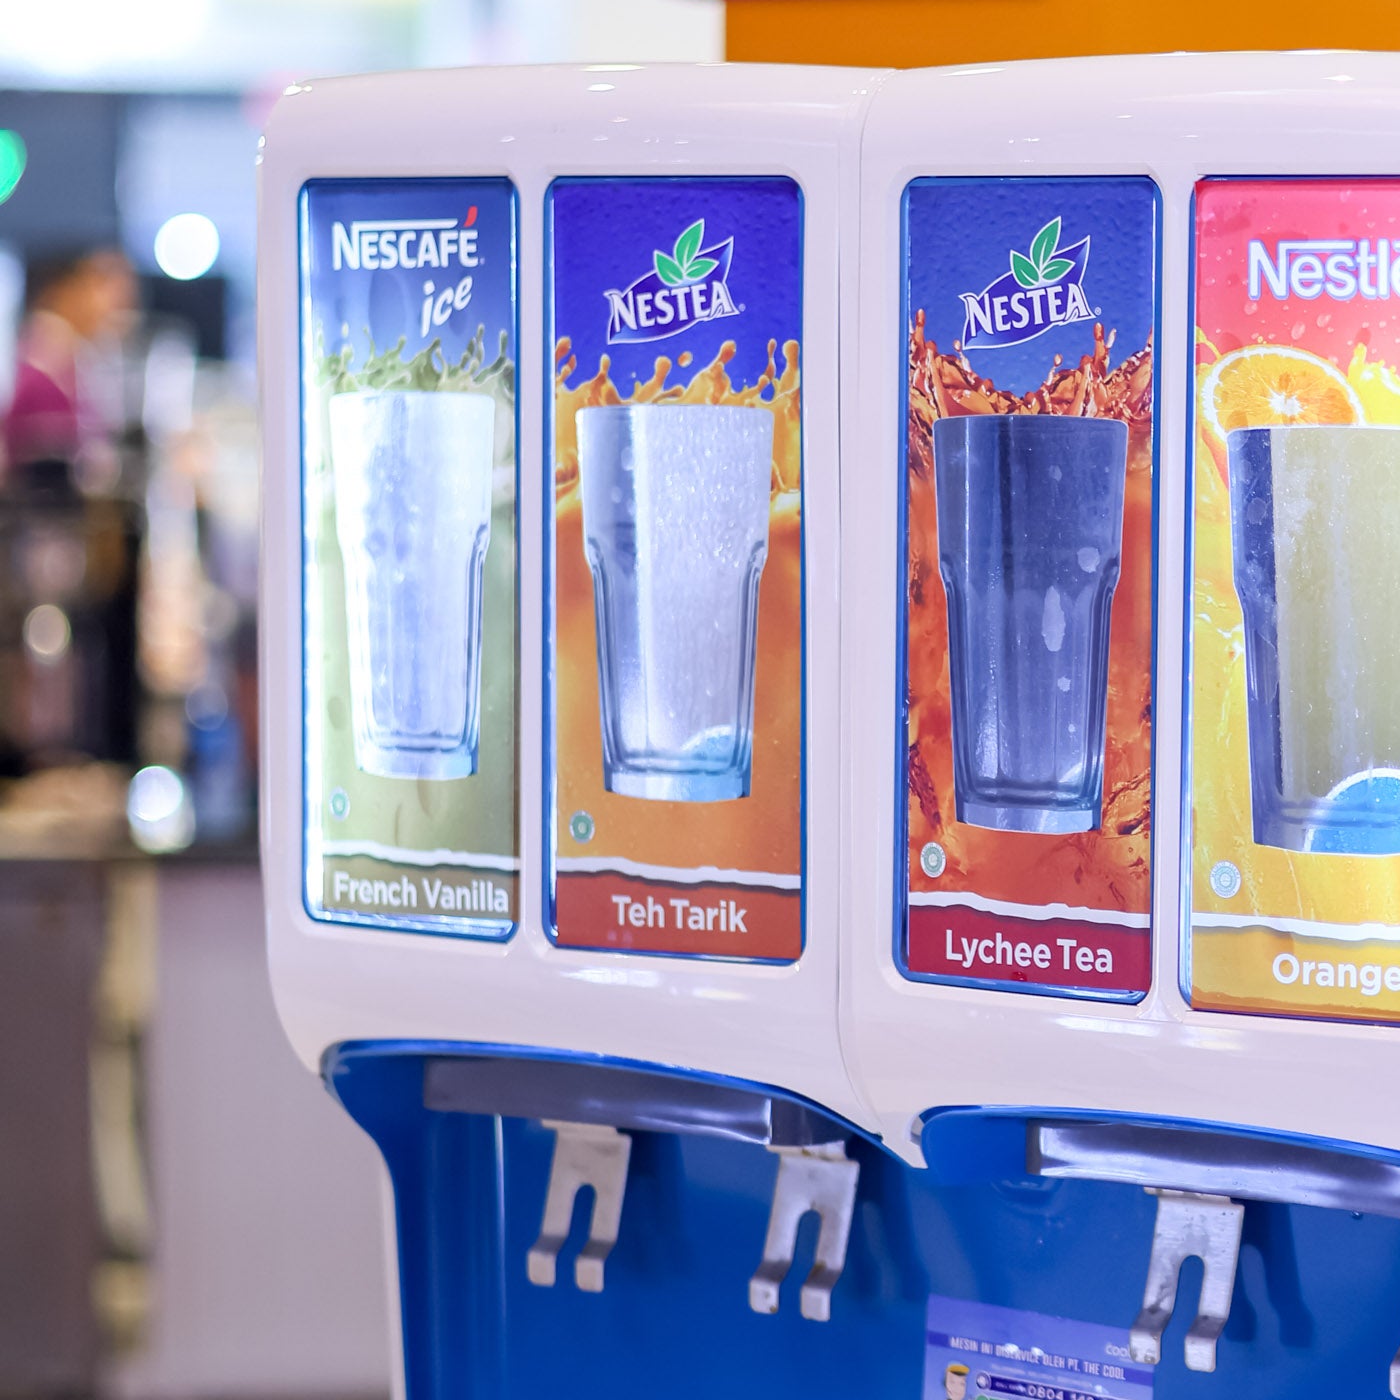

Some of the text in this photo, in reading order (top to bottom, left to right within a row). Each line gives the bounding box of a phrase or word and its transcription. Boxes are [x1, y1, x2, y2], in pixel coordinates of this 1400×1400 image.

[333, 207, 479, 270] NESCAFÉ
[421, 276, 473, 338] ice
[609, 280, 735, 334] NESTEA
[964, 283, 1092, 338] NESTEA
[333, 870, 510, 914] French Vanilla
[611, 895, 748, 934] Teh Tarik
[945, 929, 1114, 974] Lychee Tea
[950, 1335, 979, 1352] MESIN
[1042, 1352, 1065, 1369] OLEH
[1084, 1361, 1101, 1376] THE
[1103, 1364, 1126, 1381] COOL
